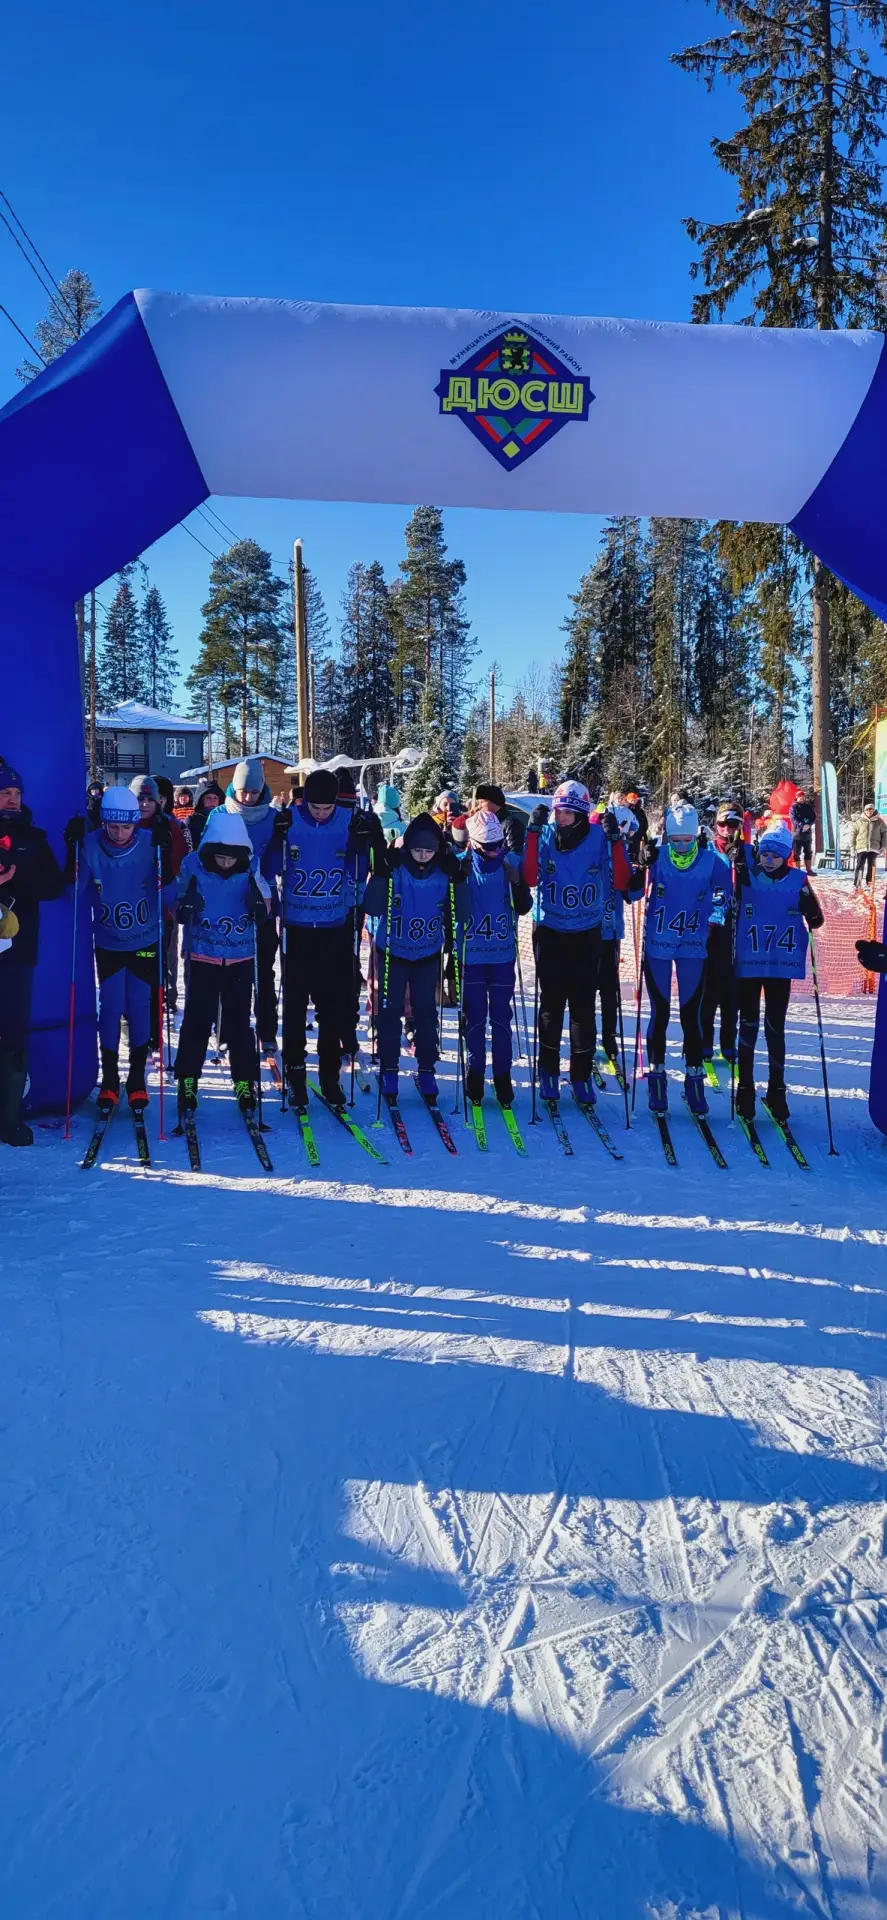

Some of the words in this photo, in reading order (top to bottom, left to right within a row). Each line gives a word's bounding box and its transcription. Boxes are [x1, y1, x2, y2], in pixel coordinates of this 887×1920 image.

[449, 320, 511, 365] МУНИЦИПАЛЬНЫЙ
[559, 349, 582, 372] РАЙОН
[443, 377, 584, 414] ДЮСШ
[292, 868, 344, 898] 222
[546, 881, 597, 909] 160
[99, 897, 150, 931] 260
[391, 915, 442, 942] 189
[465, 914, 509, 941] 243
[653, 906, 700, 938] 144
[746, 924, 797, 954] 174
